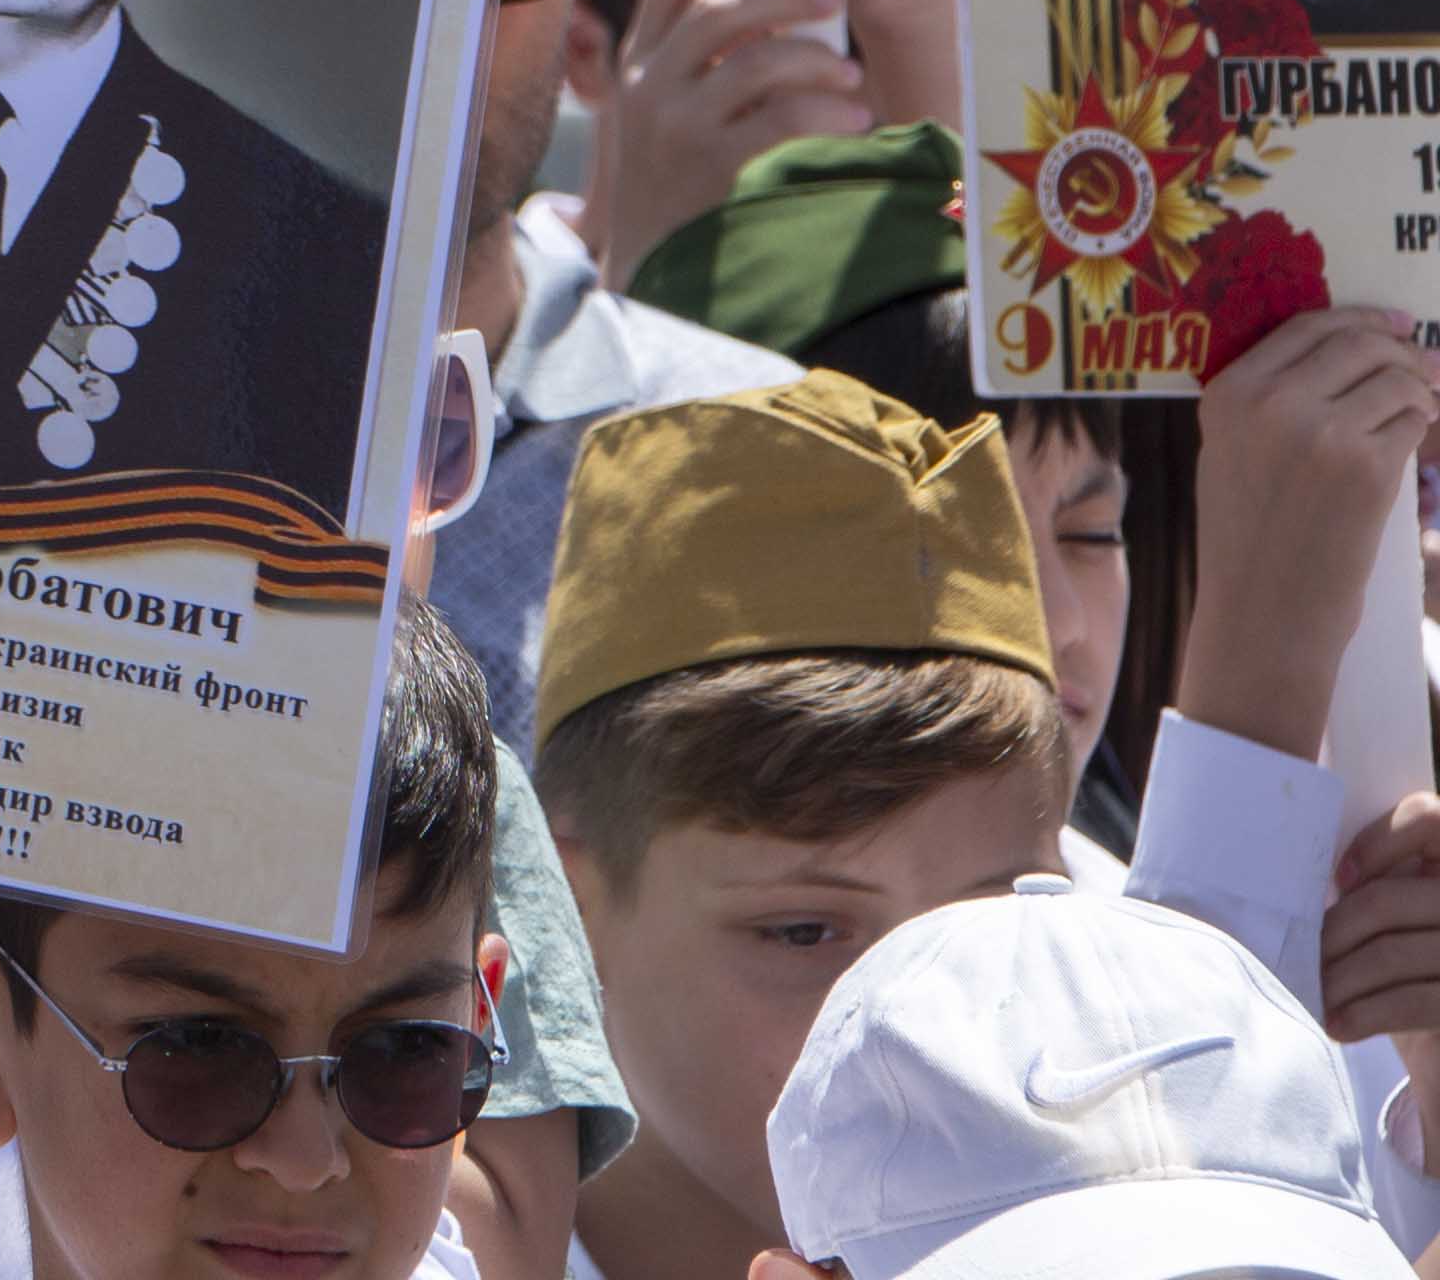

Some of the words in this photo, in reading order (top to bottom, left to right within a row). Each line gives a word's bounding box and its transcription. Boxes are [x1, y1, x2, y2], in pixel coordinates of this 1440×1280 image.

[1395, 213, 1440, 252] КР
[996, 302, 1055, 375] 9
[1081, 311, 1212, 373] МАЯ
[194, 671, 308, 719] фронт
[65, 798, 183, 844] взвода
